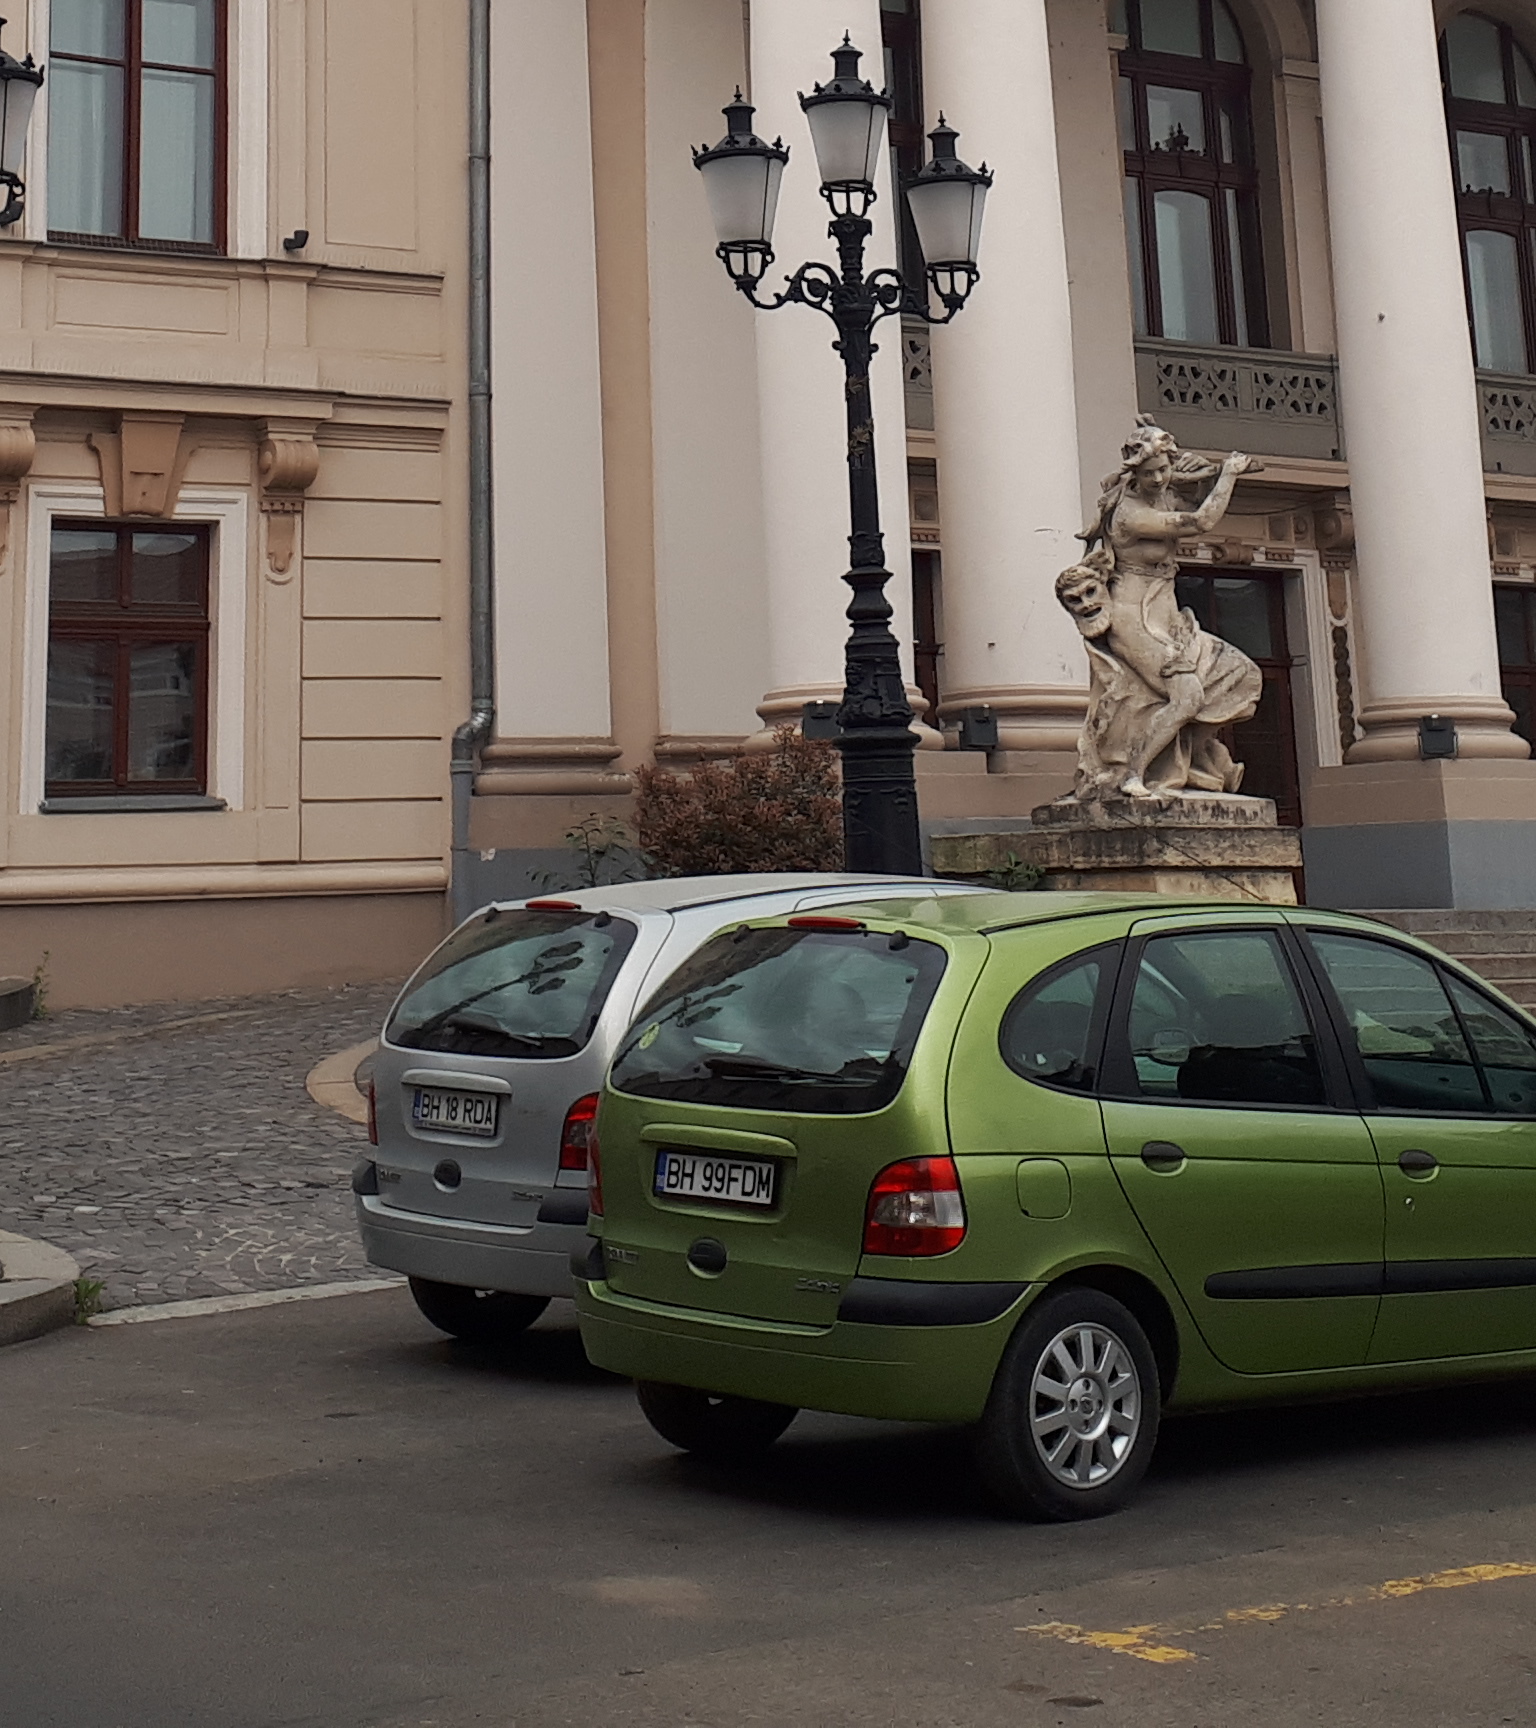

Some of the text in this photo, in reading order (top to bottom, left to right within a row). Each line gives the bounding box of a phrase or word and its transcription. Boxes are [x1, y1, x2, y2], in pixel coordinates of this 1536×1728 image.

[421, 1094, 493, 1126] BH 18 RDA
[666, 1158, 696, 1191] BH
